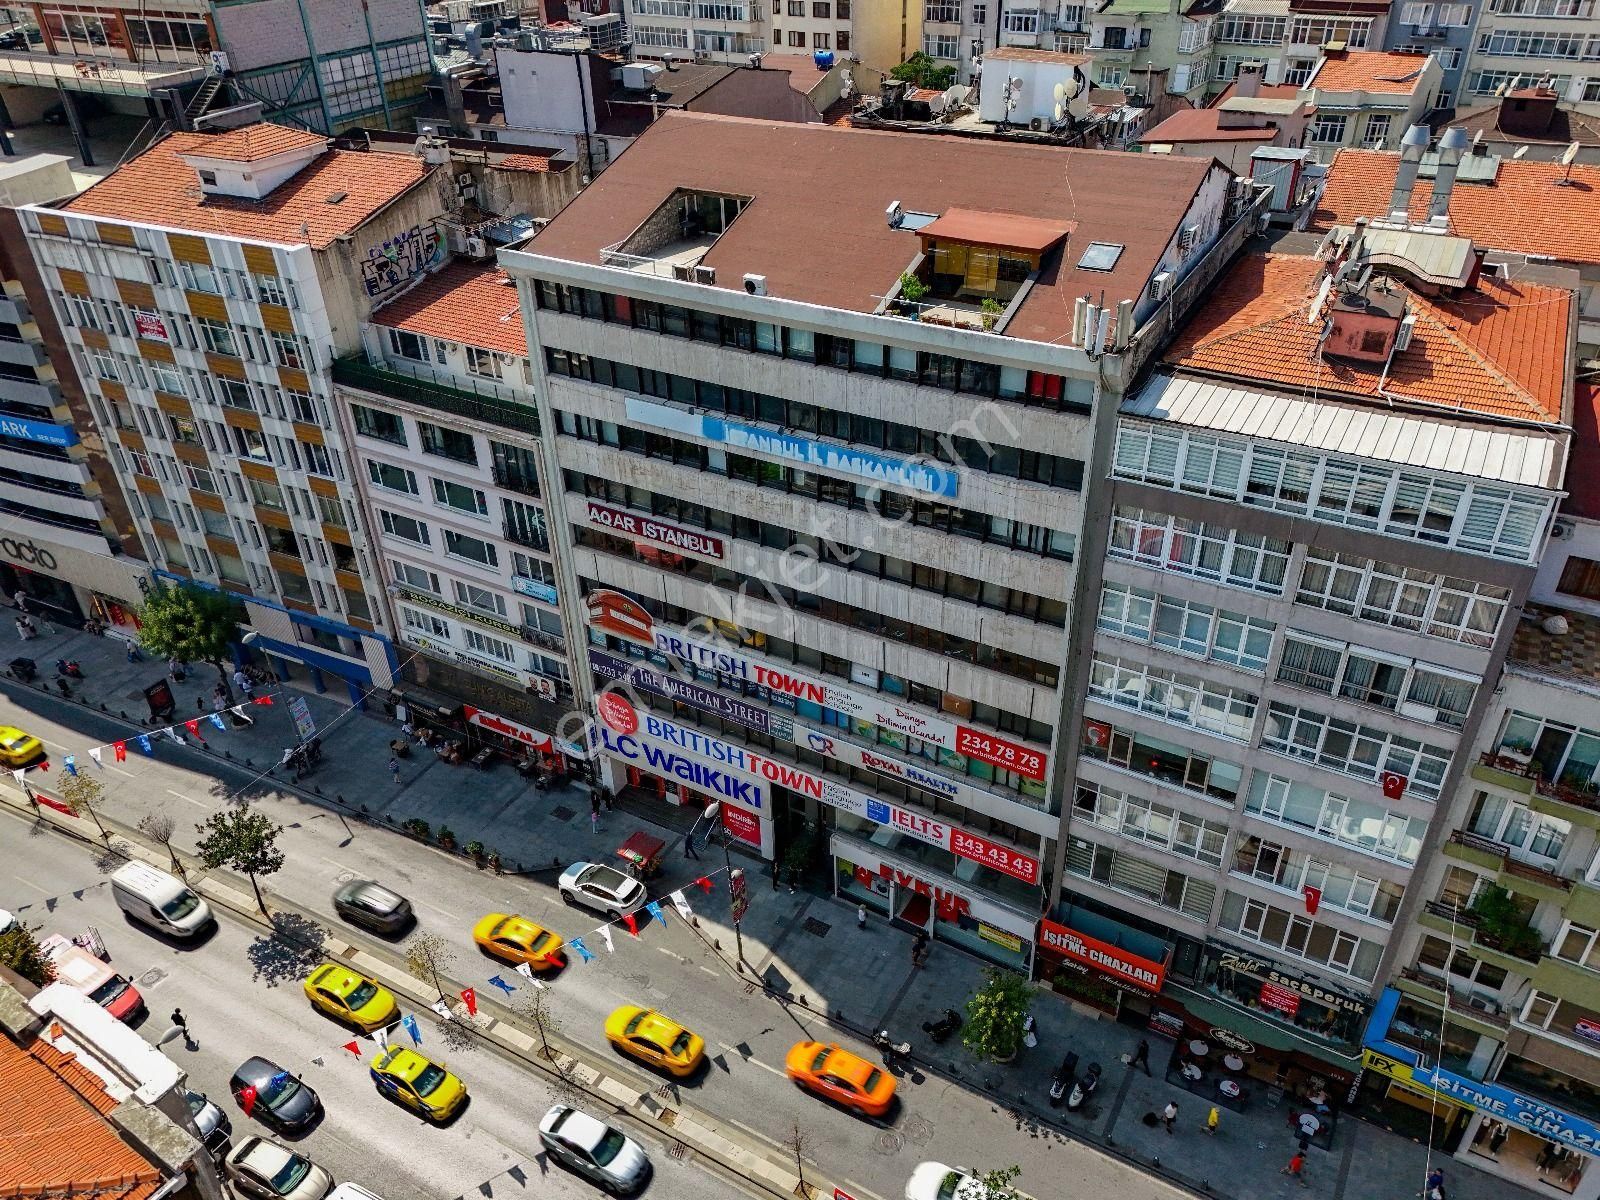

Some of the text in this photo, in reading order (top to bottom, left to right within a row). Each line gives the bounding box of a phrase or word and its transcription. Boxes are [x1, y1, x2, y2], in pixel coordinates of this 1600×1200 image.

[0, 420, 32, 439] ARK
[590, 506, 637, 532] AQAR
[0, 537, 58, 570] acto
[656, 633, 747, 678] BRITISH
[753, 664, 824, 704] TOWN
[638, 667, 659, 688] THE
[661, 676, 720, 710] AMERICAN
[725, 698, 767, 726] STREET
[825, 686, 852, 700] English
[876, 713, 946, 745] Dilimin Ucunda!
[895, 707, 927, 727] Dünya
[601, 727, 638, 759] LC
[961, 733, 1040, 769] 234 78 78
[861, 750, 958, 795] ROYAL HEALTH
[892, 808, 944, 840] IELTS
[954, 834, 1033, 874] 343 43 43
[1043, 928, 1088, 957] İŞİTME
[1089, 949, 1158, 985] CİHAZLARI
[1268, 971, 1366, 1015] saç&peruk
[1430, 1072, 1508, 1113] İŞİTME
